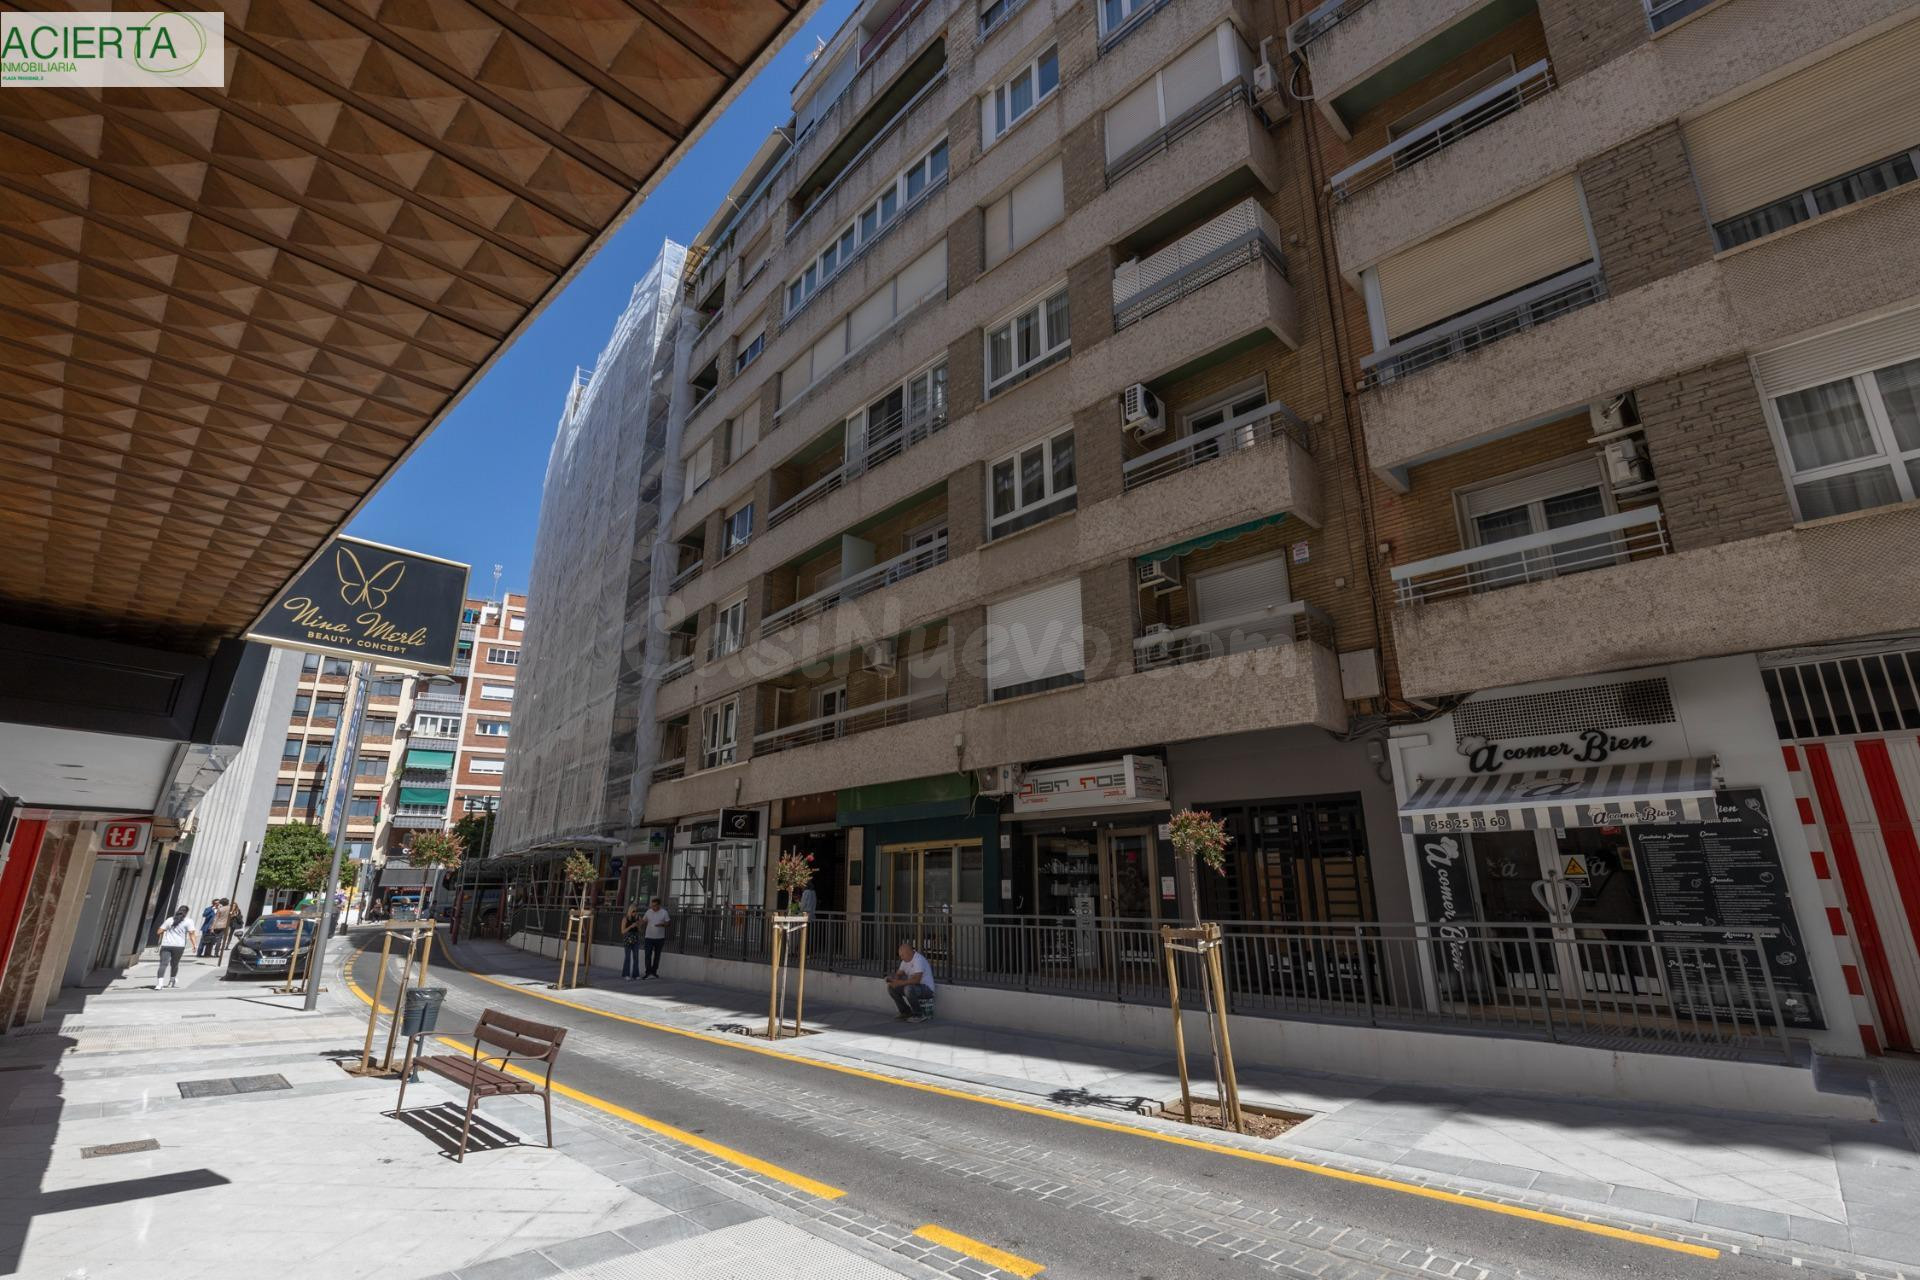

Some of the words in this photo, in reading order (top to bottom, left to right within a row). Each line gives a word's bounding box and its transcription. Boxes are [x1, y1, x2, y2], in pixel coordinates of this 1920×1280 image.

[283, 597, 351, 633] Nina
[356, 612, 428, 646] Merli
[307, 631, 353, 645] BEAUTY
[356, 640, 407, 654] CONCEPT
[1573, 730, 1653, 764] Bien
[1718, 805, 1739, 813] ien
[1430, 819, 1452, 831] 958
[1455, 818, 1470, 830] 25
[1473, 817, 1487, 829] 11
[1490, 816, 1506, 828] 60
[109, 827, 137, 846] tf
